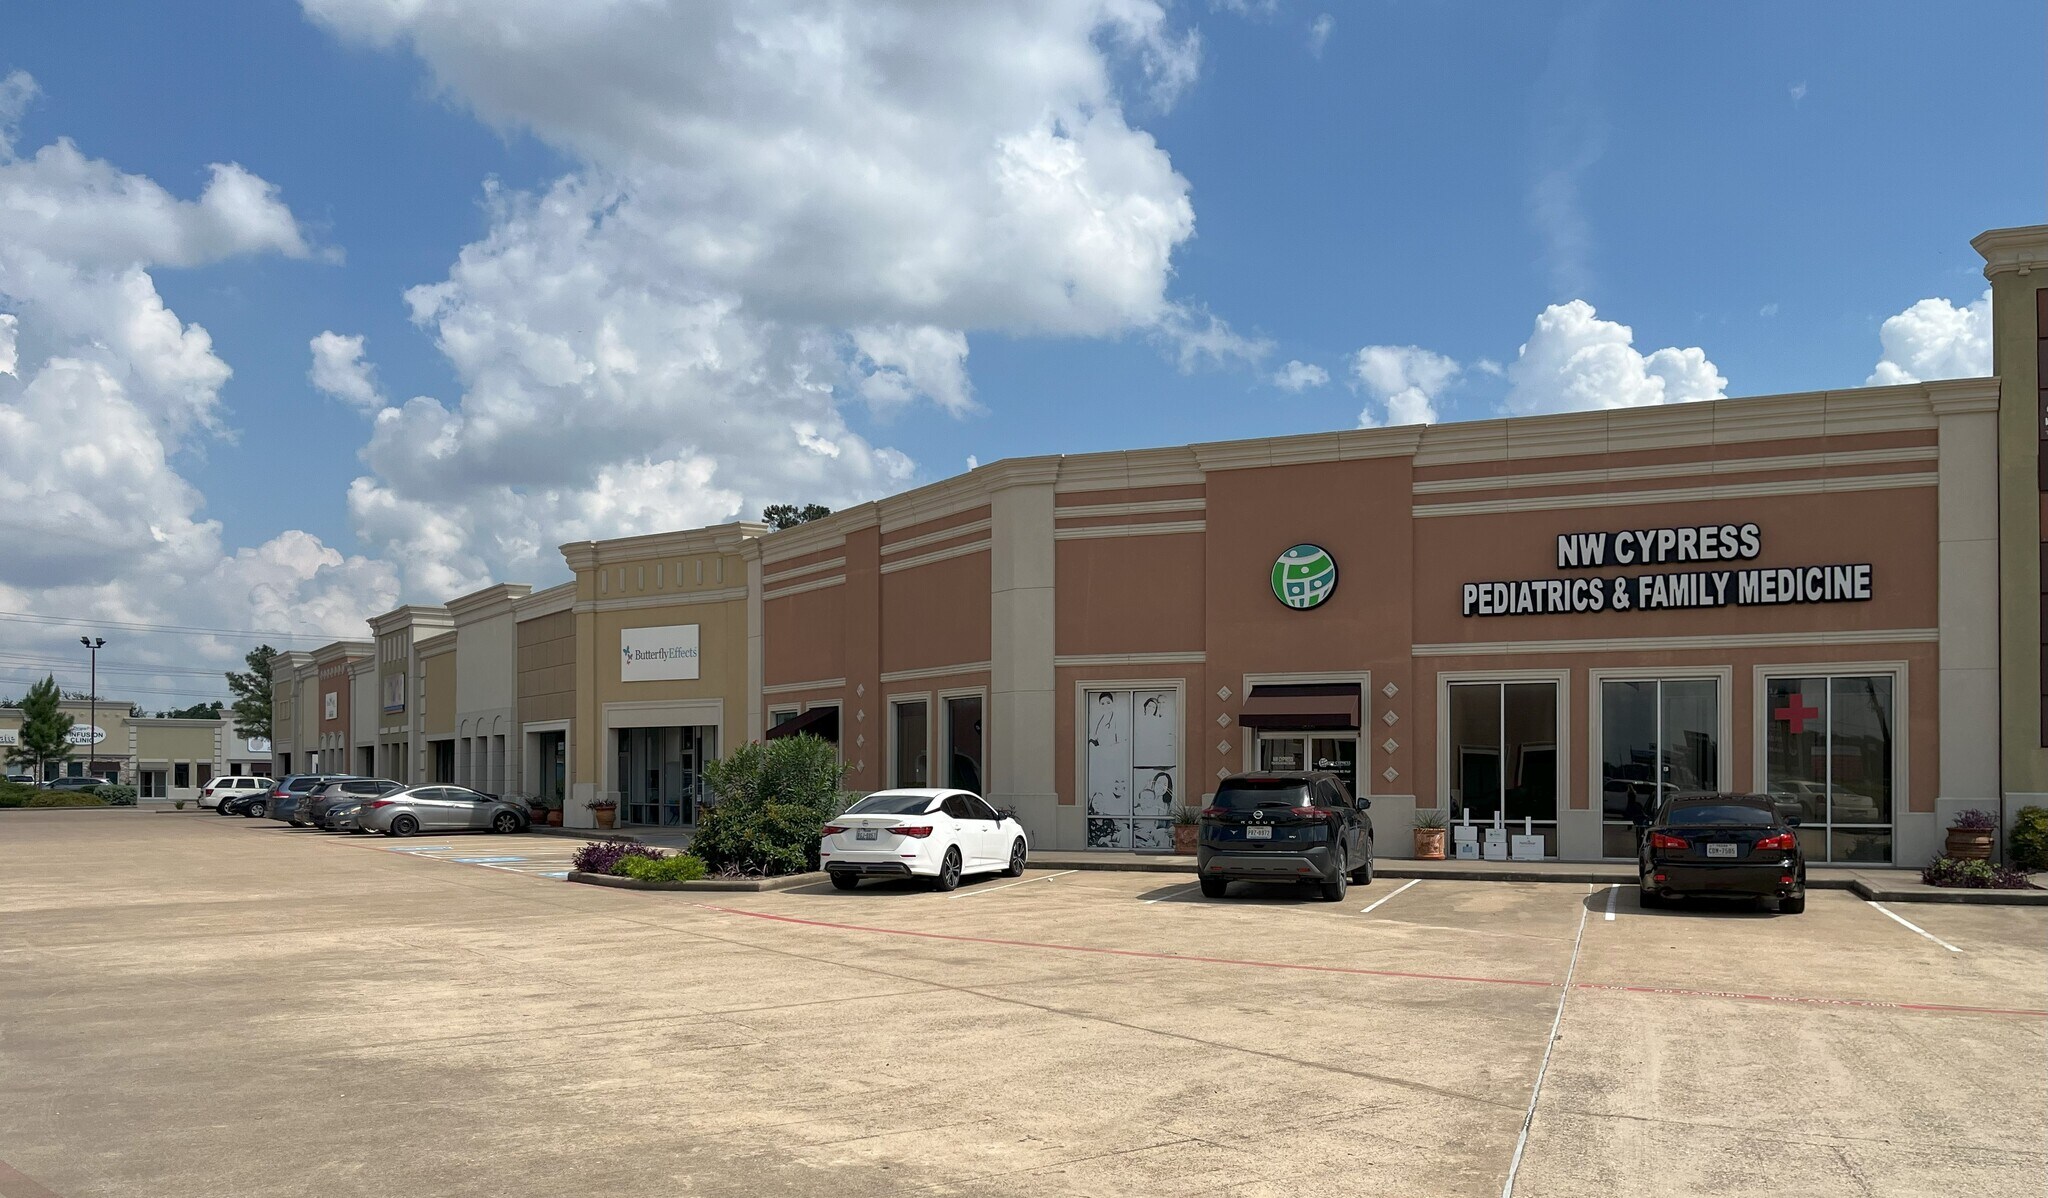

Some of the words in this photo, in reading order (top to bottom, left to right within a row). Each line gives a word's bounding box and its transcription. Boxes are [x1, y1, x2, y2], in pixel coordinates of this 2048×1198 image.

[1558, 532, 1606, 567] NW
[1614, 523, 1761, 564] CYPRESS
[1462, 577, 1604, 616] PEDIATRICS
[1611, 576, 1631, 610] &
[1638, 570, 1730, 609] FAMILY
[1736, 564, 1872, 605] MEDICINE
